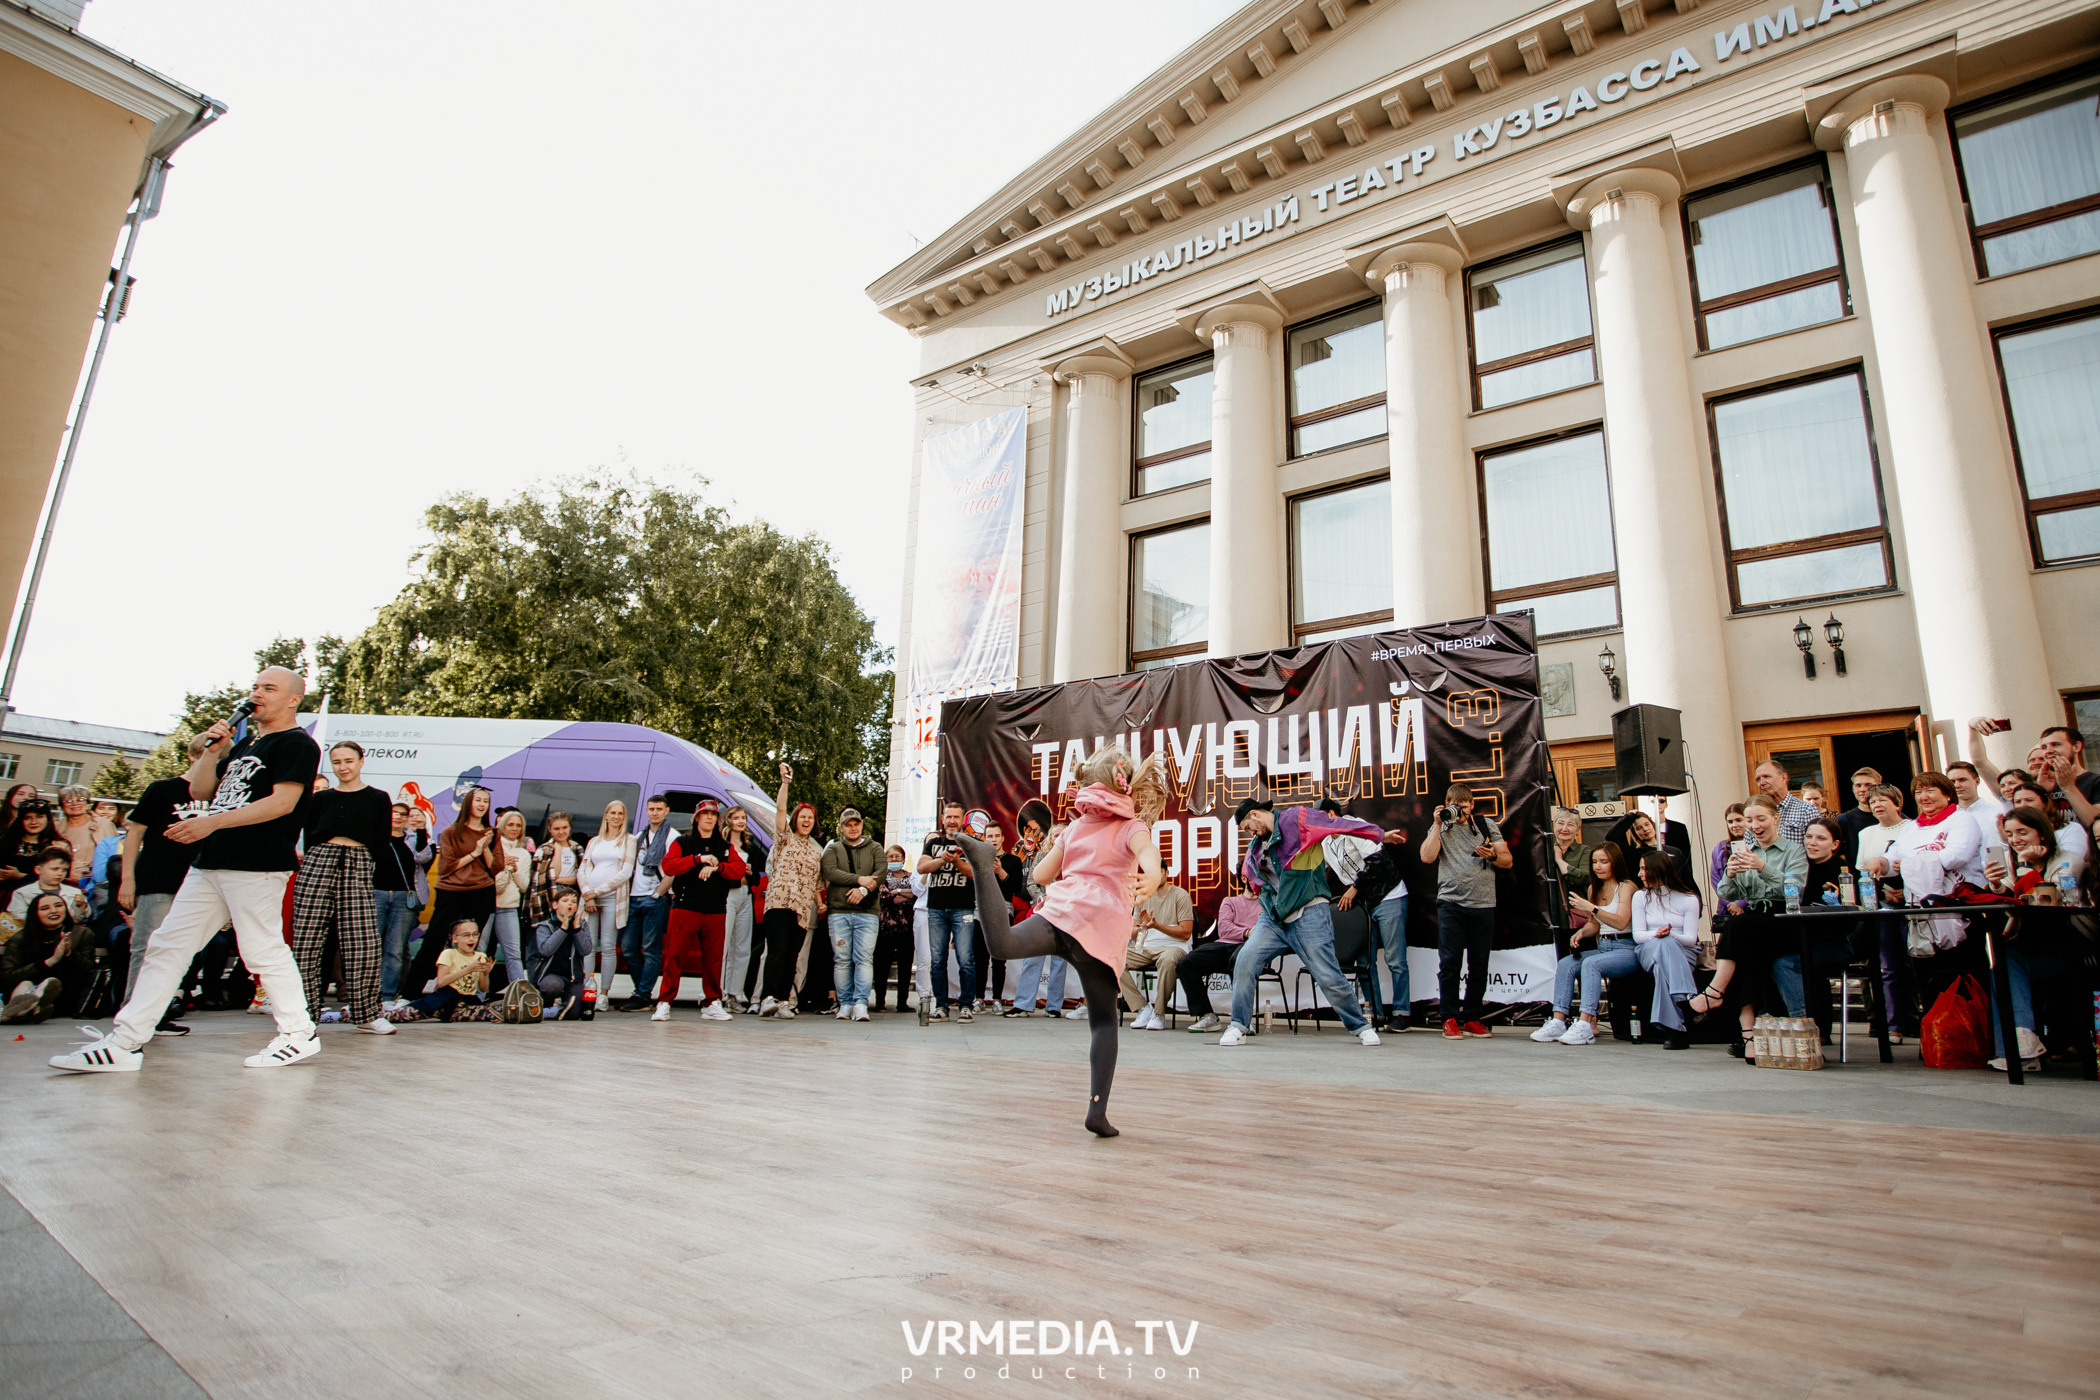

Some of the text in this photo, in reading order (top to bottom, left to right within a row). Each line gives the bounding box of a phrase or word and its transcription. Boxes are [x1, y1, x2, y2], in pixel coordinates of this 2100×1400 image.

[1046, 193, 1299, 317] МУЗЫКАЛЬНЫЙ
[1311, 145, 1435, 212] ТЕАТР
[1453, 47, 1700, 161] КУЗБАССА
[1371, 633, 1497, 662] #ВРЕМЯ_ПЕРВЫХ
[1031, 681, 1427, 796] ТАЦУЮЩИЙ
